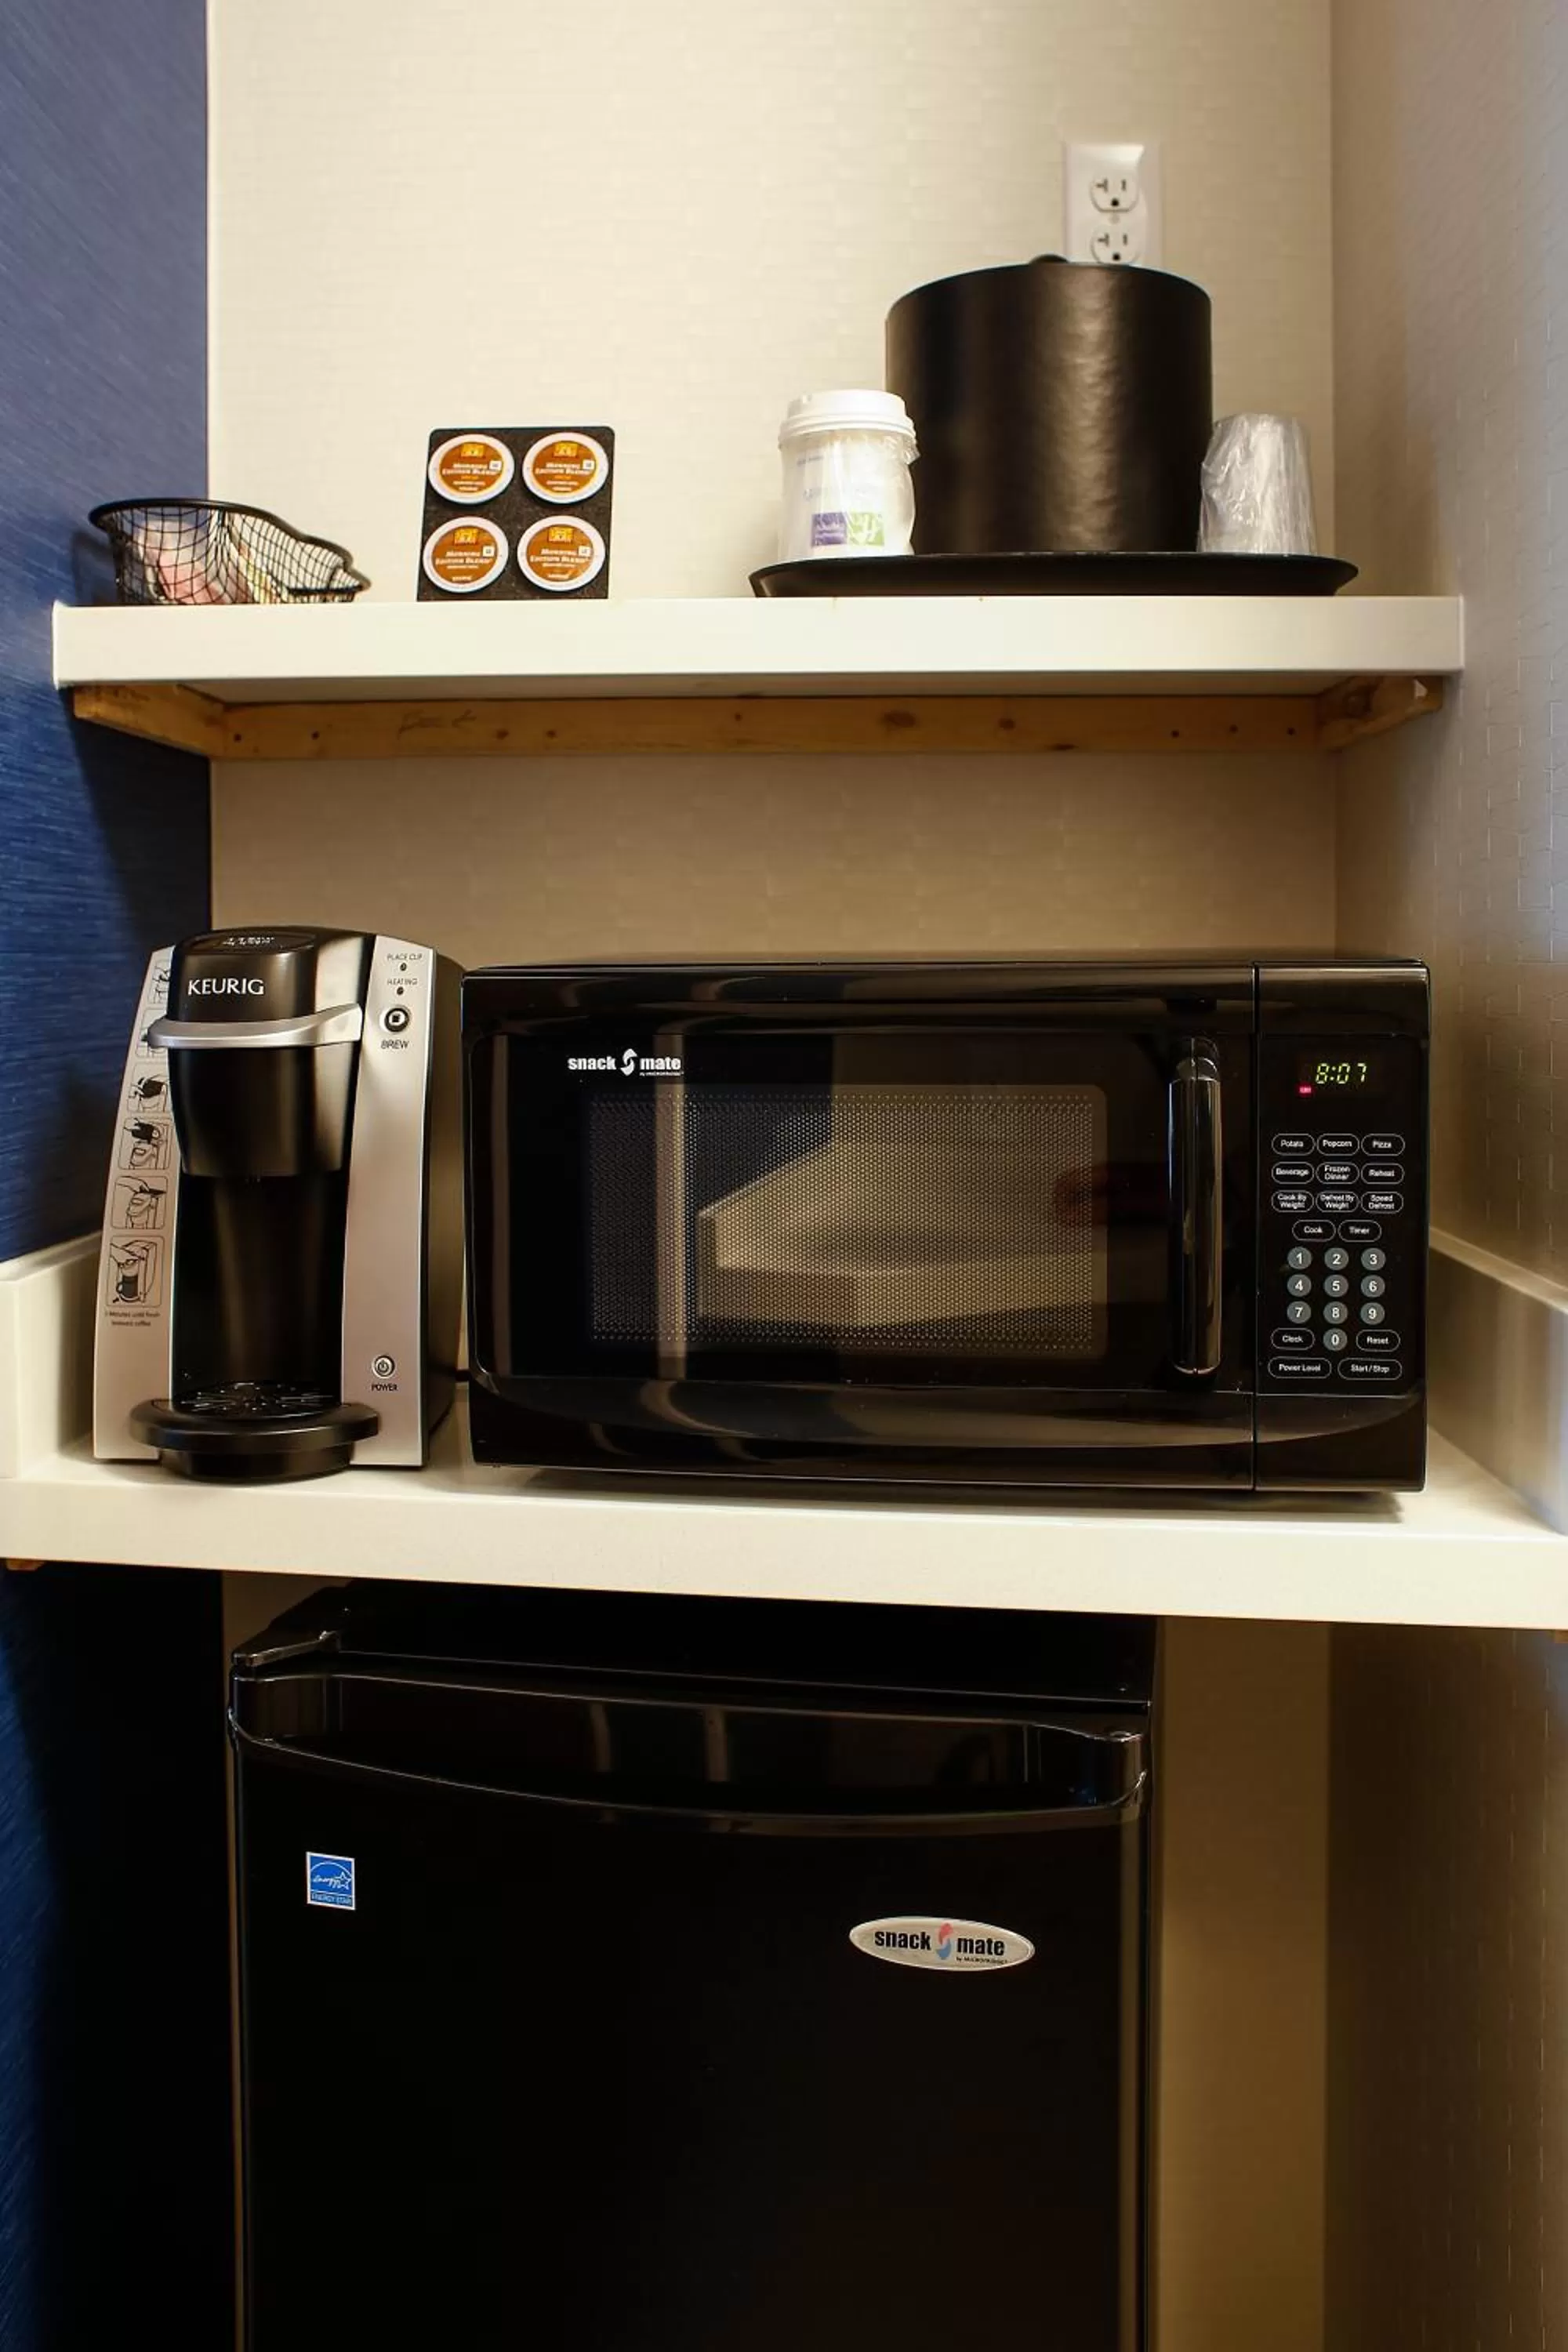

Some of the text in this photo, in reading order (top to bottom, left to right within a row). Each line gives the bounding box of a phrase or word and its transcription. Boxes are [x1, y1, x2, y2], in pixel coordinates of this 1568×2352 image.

[188, 978, 264, 996] KEURIG
[380, 1040, 409, 1050] BREW
[567, 1055, 681, 1070] snack mate
[1315, 1062, 1367, 1084] 8:07
[1280, 1139, 1304, 1148] Potato
[1323, 1139, 1352, 1149] Popcorn
[1372, 1140, 1392, 1149] Pizza
[1276, 1168, 1309, 1177] Beverage
[1368, 1169, 1395, 1178] Reheat
[1298, 1194, 1307, 1203] By
[1345, 1194, 1355, 1203] By
[1370, 1194, 1393, 1203] Speed
[1280, 1201, 1305, 1210] Weight
[1348, 1226, 1370, 1235] Timer
[1296, 1253, 1303, 1265] 1
[1332, 1254, 1341, 1265] 2
[1370, 1254, 1377, 1265] 3
[1294, 1280, 1303, 1291] 4
[1332, 1280, 1340, 1291] 5
[1369, 1281, 1377, 1292] 6
[1295, 1307, 1303, 1318] 7
[1332, 1307, 1340, 1318] 8
[1368, 1308, 1377, 1319] 9
[1332, 1334, 1340, 1345] 0
[1367, 1336, 1388, 1345] Reset
[371, 1383, 397, 1392] POWER
[874, 1931, 1004, 1956] snack mate
